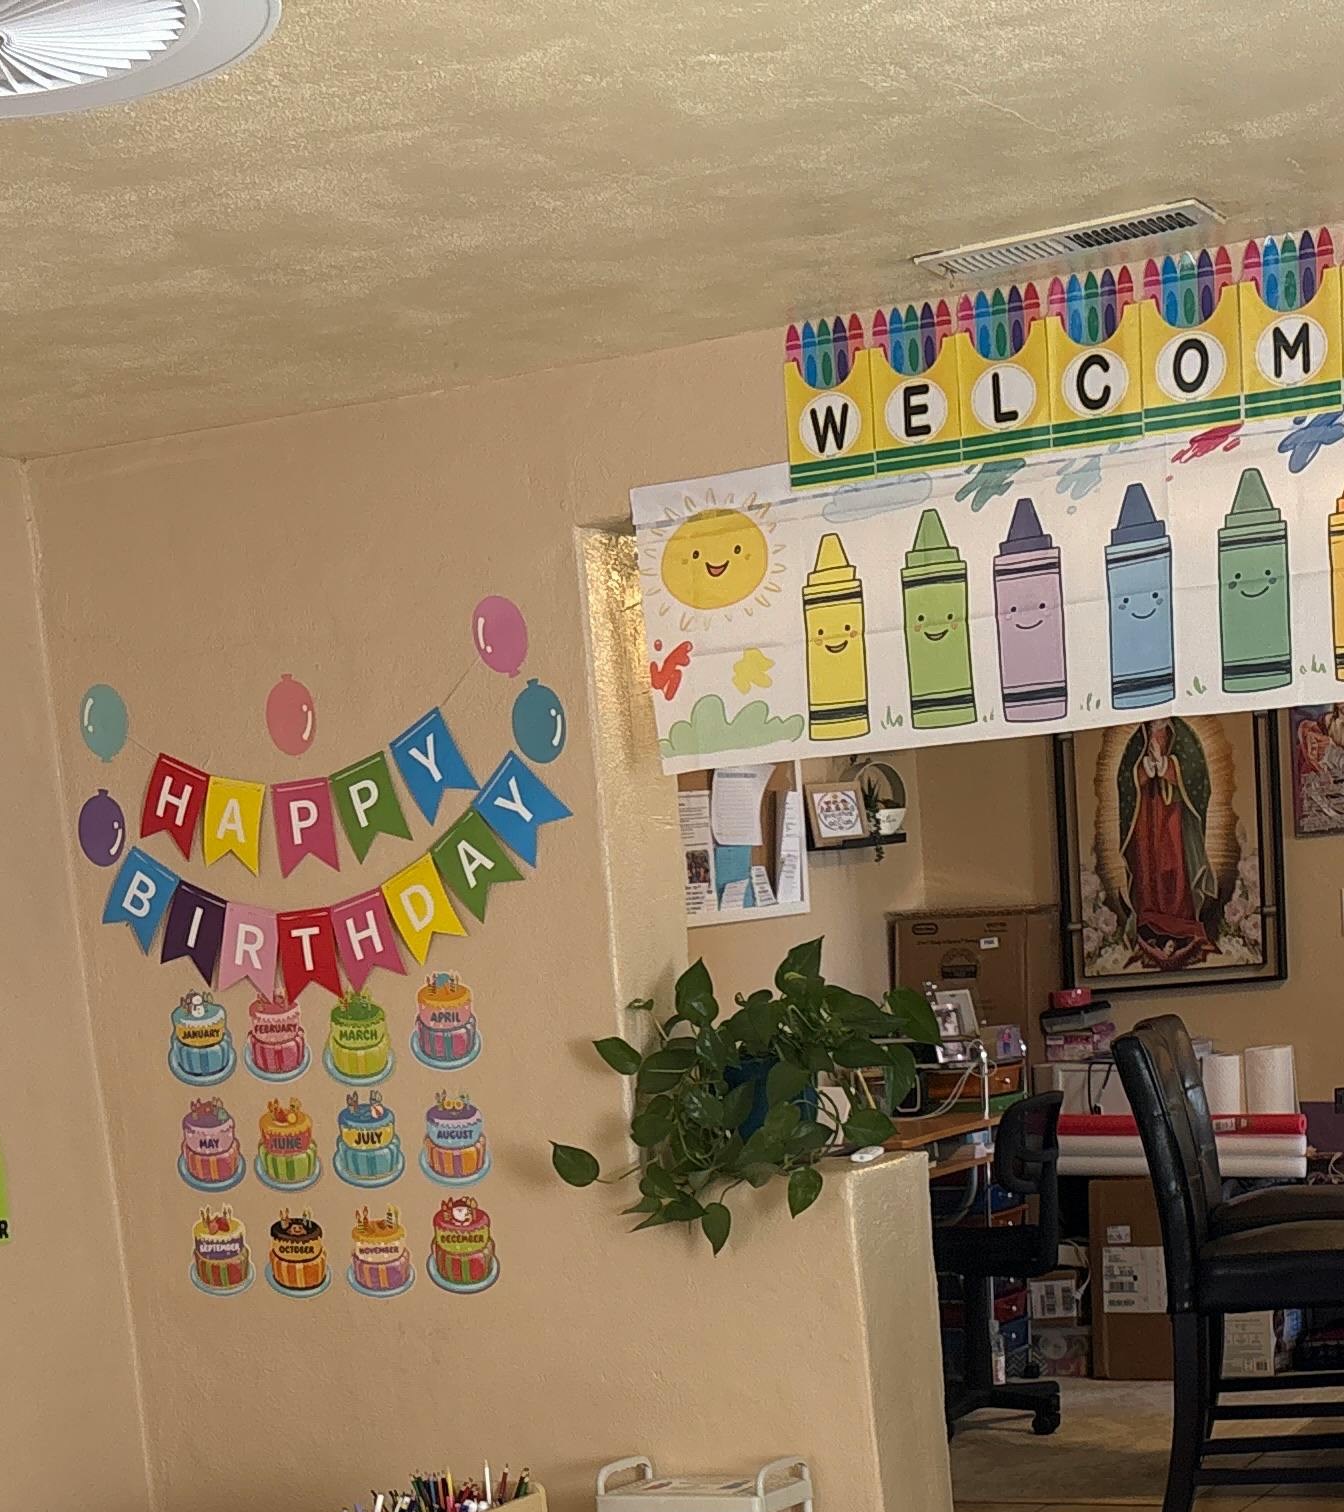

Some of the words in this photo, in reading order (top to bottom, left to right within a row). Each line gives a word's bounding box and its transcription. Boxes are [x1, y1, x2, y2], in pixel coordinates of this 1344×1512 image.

[155, 733, 444, 845] HAPPY
[121, 777, 534, 972] BIRTHDAY
[430, 1010, 461, 1024] APRIL
[182, 1028, 220, 1040] JANUARY
[255, 1023, 297, 1035] FEBRUARY
[339, 1028, 378, 1041] MARCH
[354, 1130, 383, 1145] JULY
[436, 1129, 474, 1142] AUGUST
[199, 1138, 220, 1150] MAY
[271, 1136, 302, 1151] JUNE
[440, 1234, 484, 1244] DECEMBER
[199, 1242, 240, 1253] SEPTEMBER
[278, 1245, 315, 1255] OCTOBER
[359, 1246, 399, 1255] NOVEMBER
